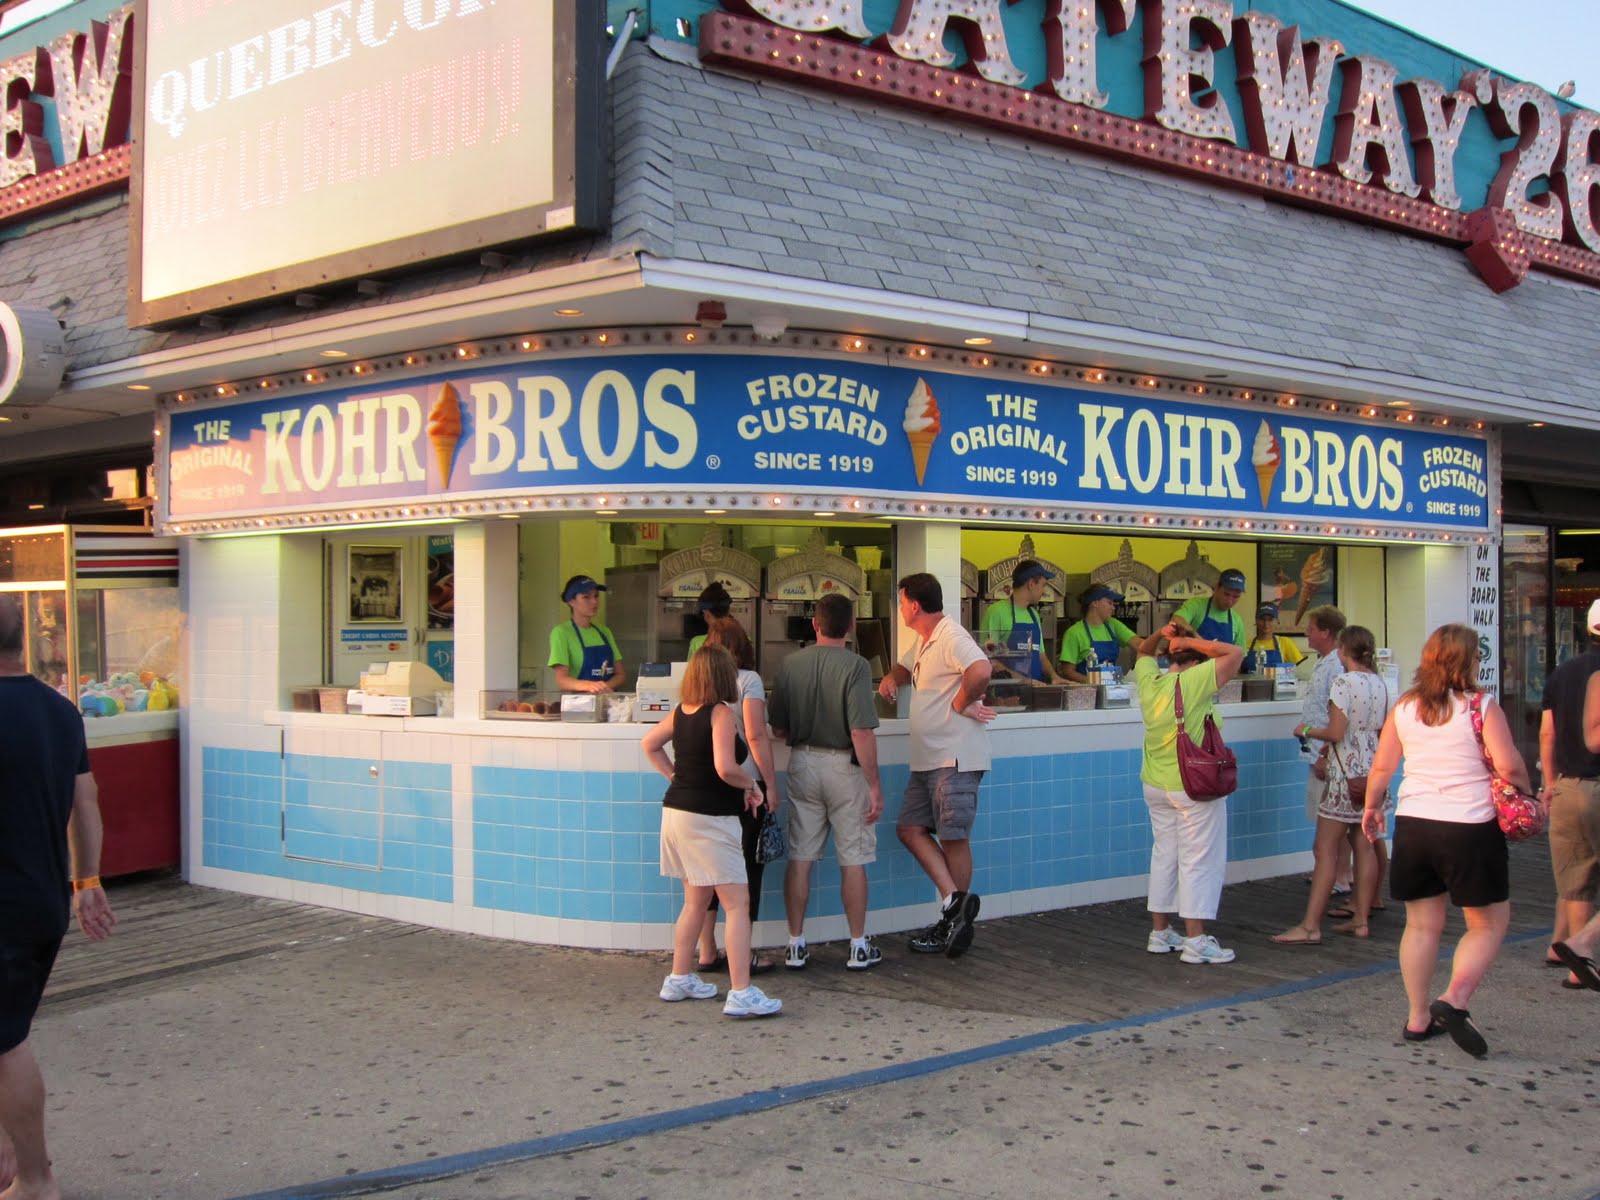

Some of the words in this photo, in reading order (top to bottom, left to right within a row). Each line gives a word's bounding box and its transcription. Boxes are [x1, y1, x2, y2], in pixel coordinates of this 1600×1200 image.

[150, 0, 496, 138] QUEBECO
[746, 372, 880, 408] FROZEN
[986, 394, 1038, 421] THE
[193, 420, 232, 443] THE
[261, 393, 426, 494] KOHR
[469, 368, 698, 475] BROS
[737, 405, 887, 447] CUSTARD
[950, 424, 1069, 466] ORIGINAL
[1078, 403, 1246, 499] KOHR
[1281, 426, 1404, 512] BROS
[172, 447, 253, 481] ORIGINAL
[754, 451, 821, 471] SINCE
[828, 454, 874, 473] 1919
[1423, 446, 1482, 474] FROZEN
[966, 465, 1015, 484] SINCE
[1021, 469, 1057, 487] 1919
[1419, 469, 1487, 498] CUSTARD
[1426, 501, 1456, 516] SINCE
[1458, 504, 1481, 517] 1919
[1476, 545, 1488, 560] ON
[1475, 566, 1491, 582] THE
[1471, 587, 1496, 605] BOARD
[1473, 608, 1494, 626] WALK
[1476, 668, 1495, 680] OST
